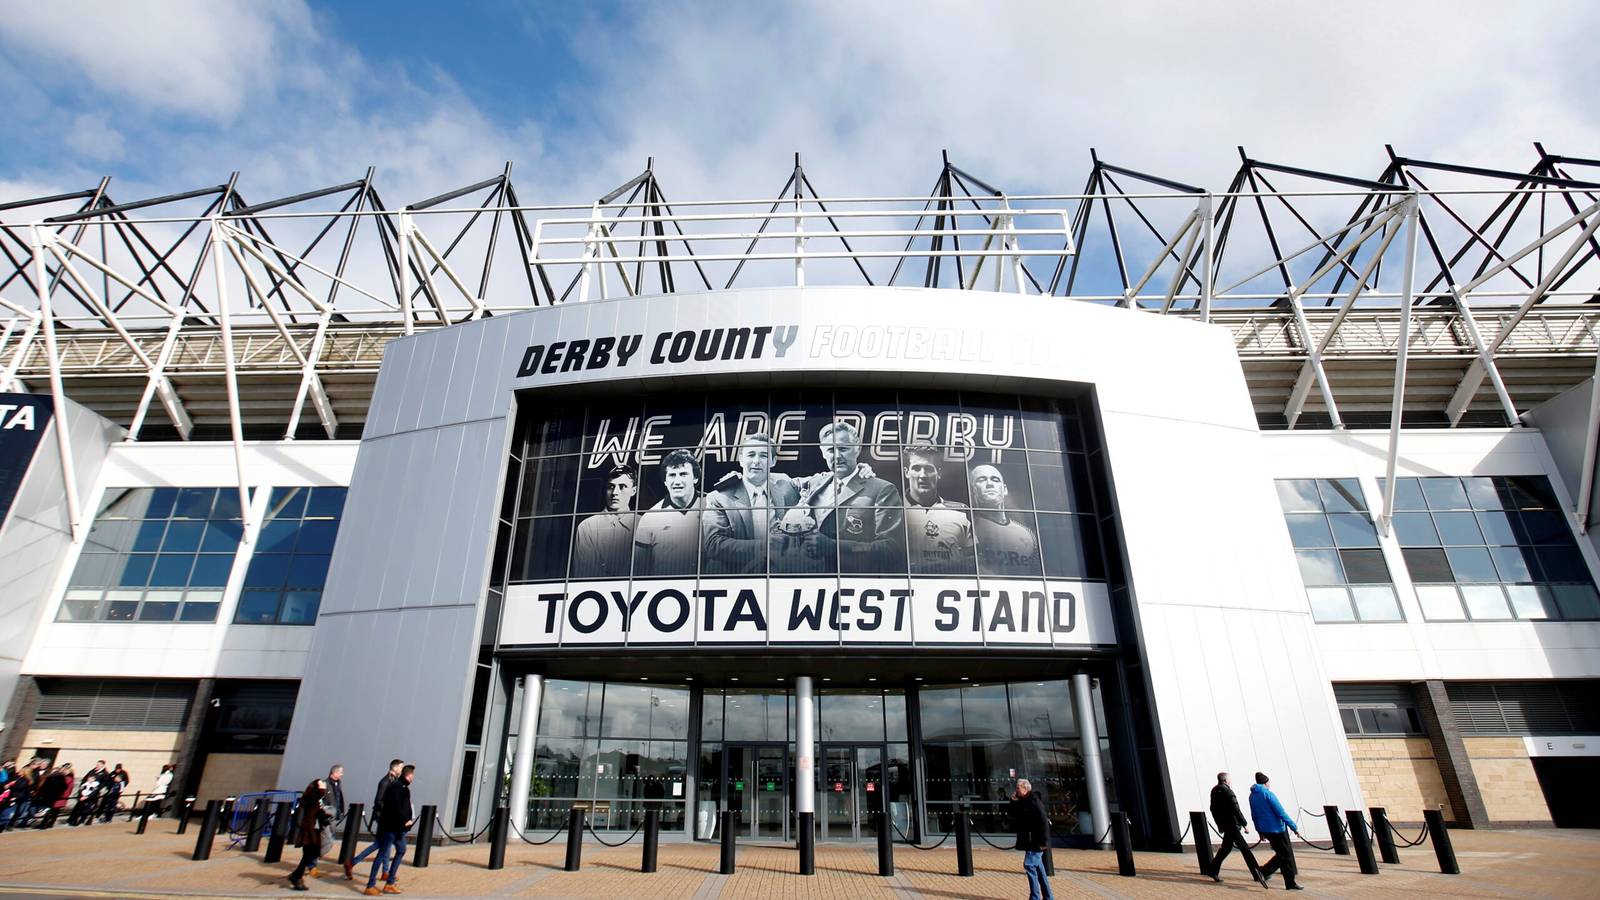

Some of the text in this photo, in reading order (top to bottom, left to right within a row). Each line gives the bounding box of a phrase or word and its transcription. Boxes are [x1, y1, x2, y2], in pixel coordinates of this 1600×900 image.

[516, 334, 643, 378] DERBY
[650, 325, 799, 365] COUNTY
[809, 325, 995, 363] FOOTBALL
[588, 414, 672, 469] WE
[695, 410, 807, 463] ARE
[538, 588, 1076, 634] TOYOTA WEST STAND
[1547, 742, 1553, 751] E
